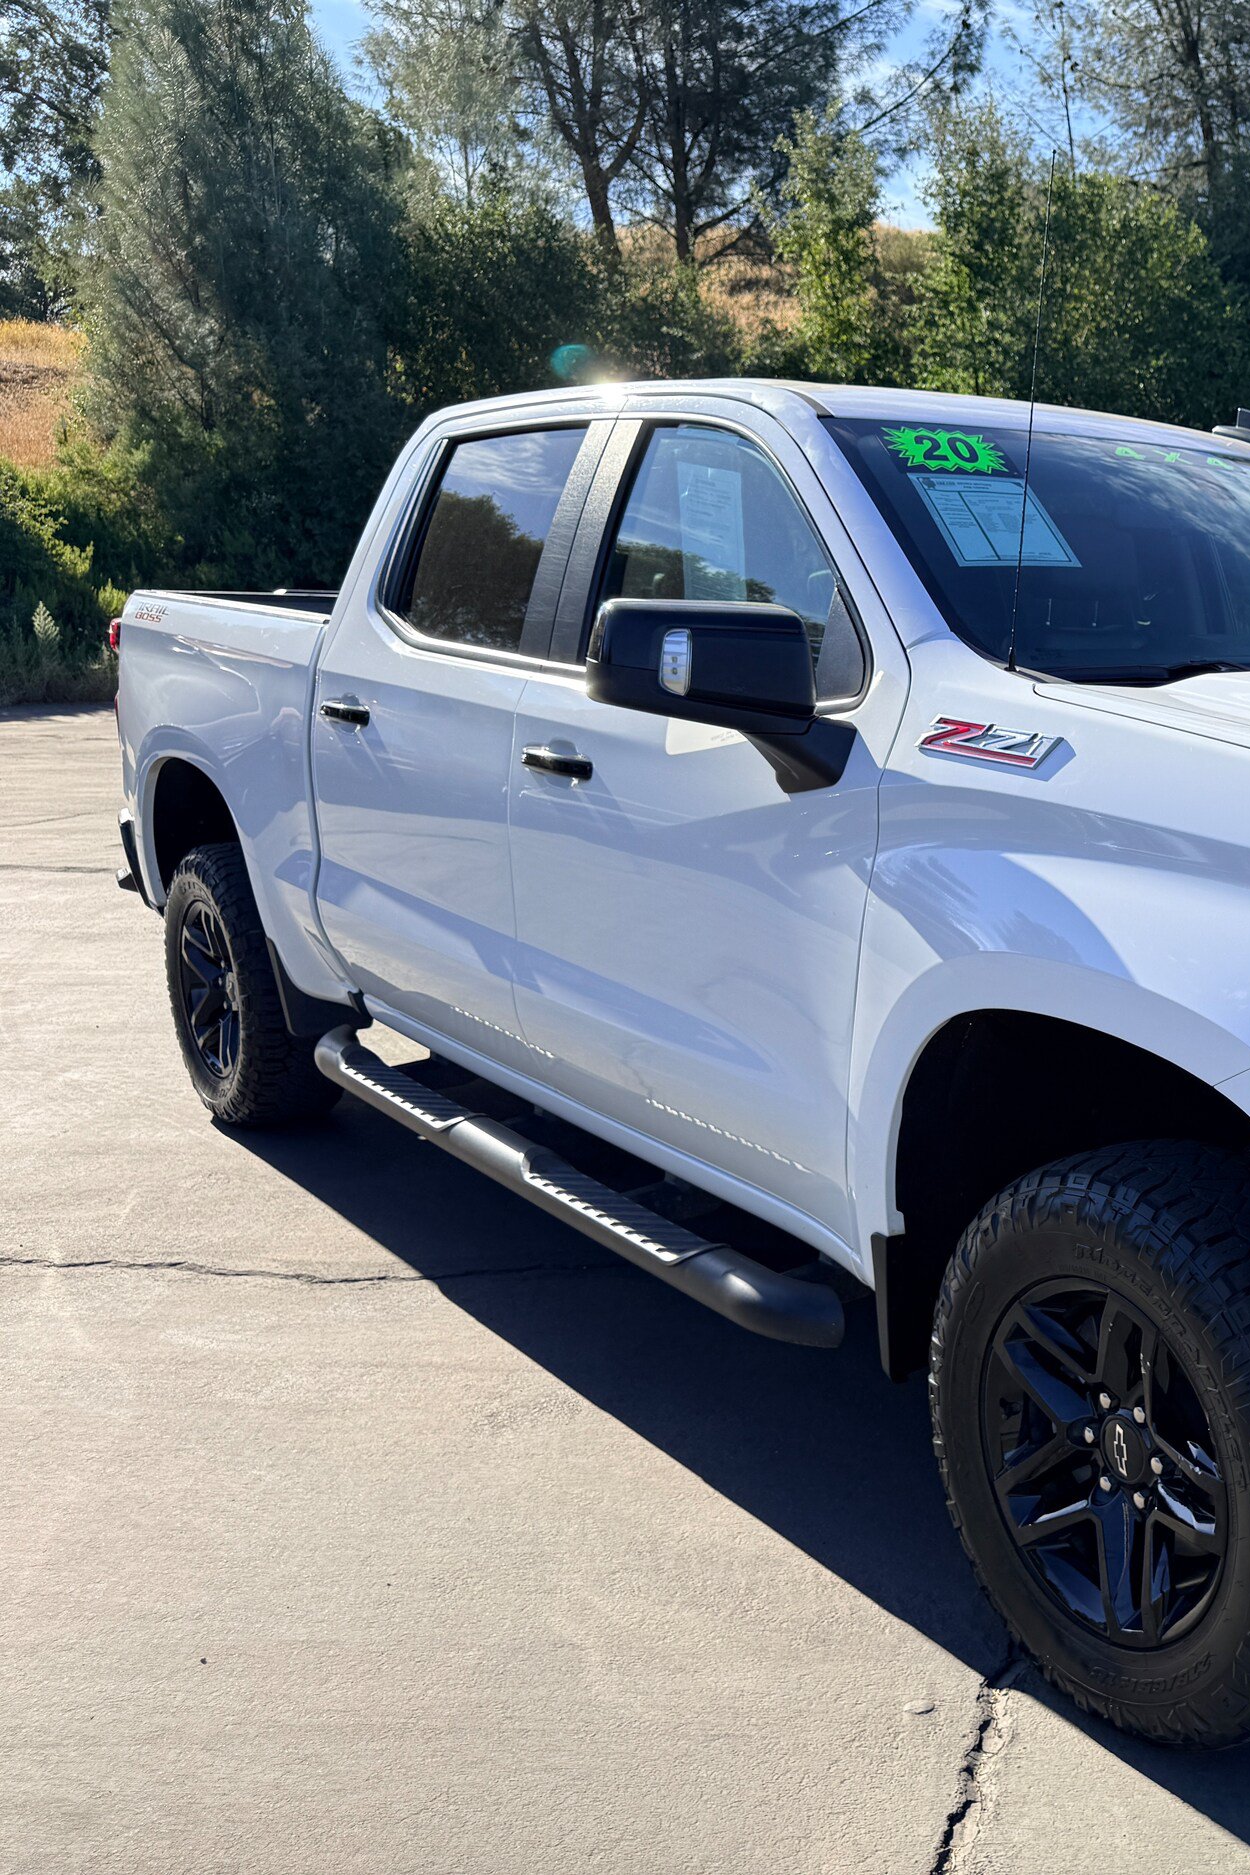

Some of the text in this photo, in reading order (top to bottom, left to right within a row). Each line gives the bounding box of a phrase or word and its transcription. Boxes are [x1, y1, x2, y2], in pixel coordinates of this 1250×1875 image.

[914, 434, 979, 463] 20
[135, 611, 162, 623] BOSS
[138, 601, 170, 616] TRAIL
[914, 713, 1064, 770] Z71
